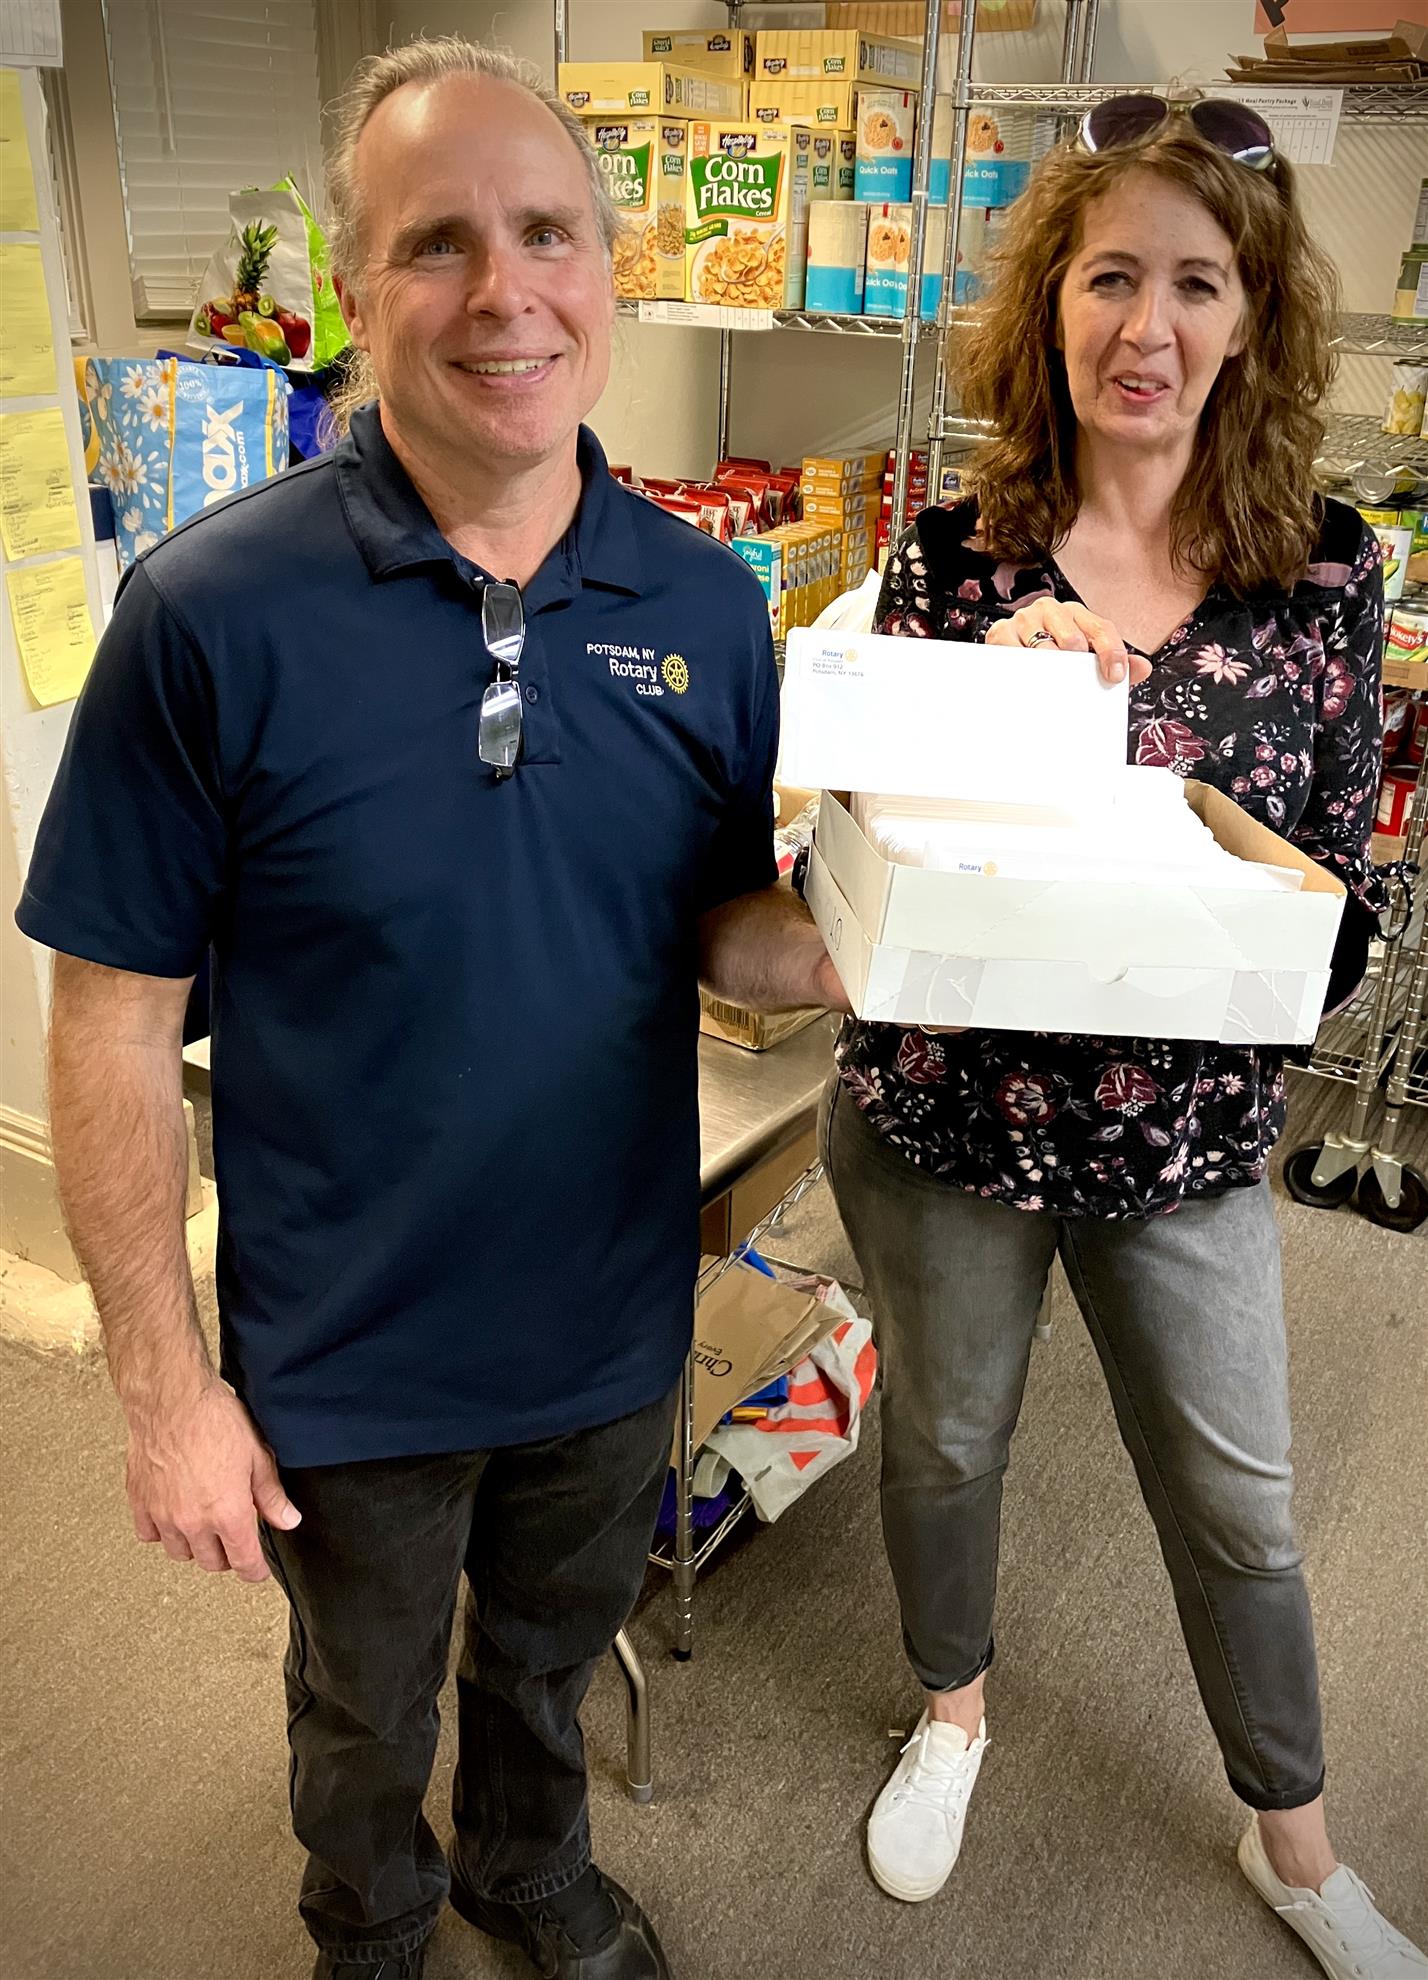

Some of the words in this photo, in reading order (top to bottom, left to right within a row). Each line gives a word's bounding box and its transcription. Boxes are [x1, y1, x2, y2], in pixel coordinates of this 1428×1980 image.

[599, 154, 636, 174] orn
[705, 156, 765, 184] Corn
[860, 166, 879, 175] Quick
[881, 167, 898, 175] Oats
[609, 176, 644, 200] kes
[700, 181, 773, 211] Flakes
[587, 643, 640, 661] POTSDAM,
[642, 648, 655, 660] NY
[822, 650, 843, 658] Rotary
[609, 658, 657, 682] Rotary
[636, 684, 664, 696] CLUB
[959, 862, 982, 873] Rotary
